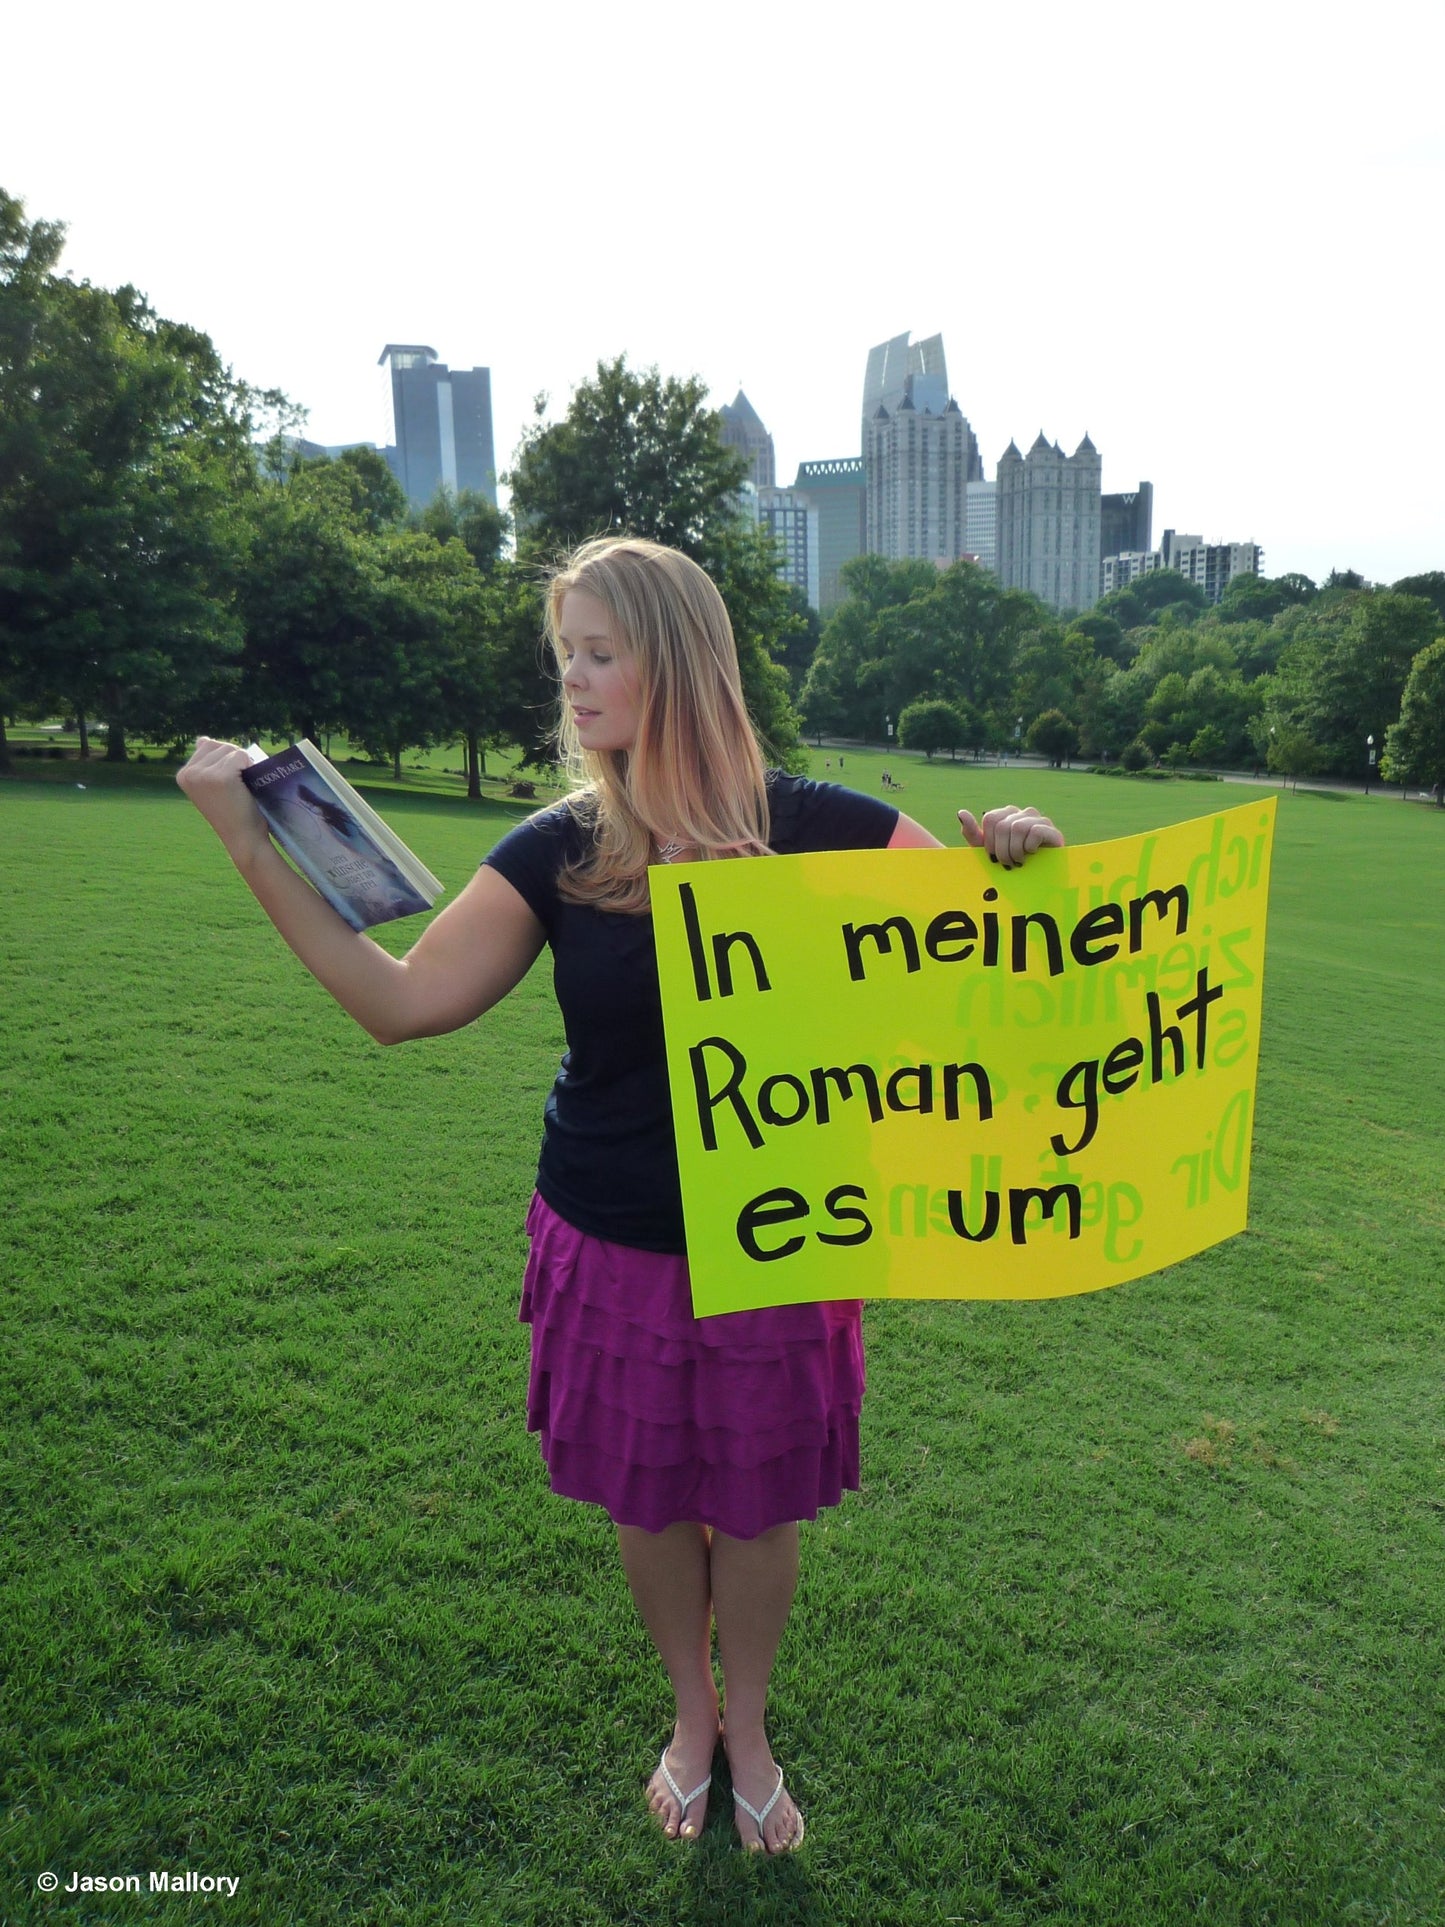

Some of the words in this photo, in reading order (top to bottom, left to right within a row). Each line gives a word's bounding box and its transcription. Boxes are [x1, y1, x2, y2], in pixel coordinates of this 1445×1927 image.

[1122, 494, 1136, 505] W
[679, 882, 771, 1001] In
[842, 884, 1189, 982] meinem
[688, 1036, 993, 1151] Roman
[1049, 966, 1223, 1156] geht
[736, 1184, 873, 1262] es
[948, 1183, 1082, 1245] um
